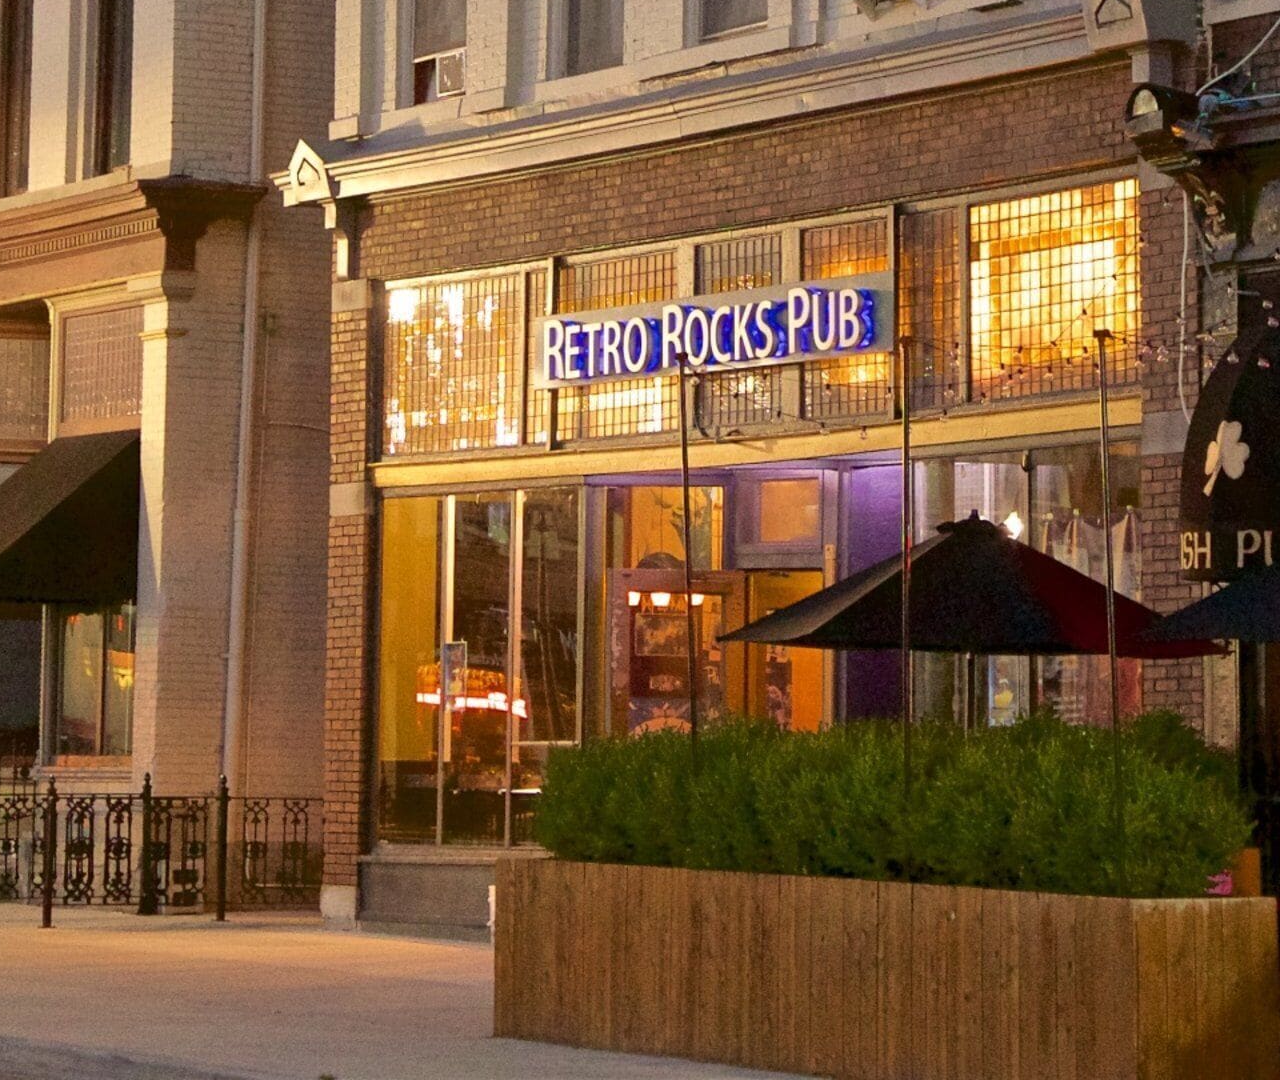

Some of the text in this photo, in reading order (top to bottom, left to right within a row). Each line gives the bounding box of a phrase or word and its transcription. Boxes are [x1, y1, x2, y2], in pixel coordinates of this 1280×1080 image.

[542, 286, 862, 380] RETRO ROCKS PUB
